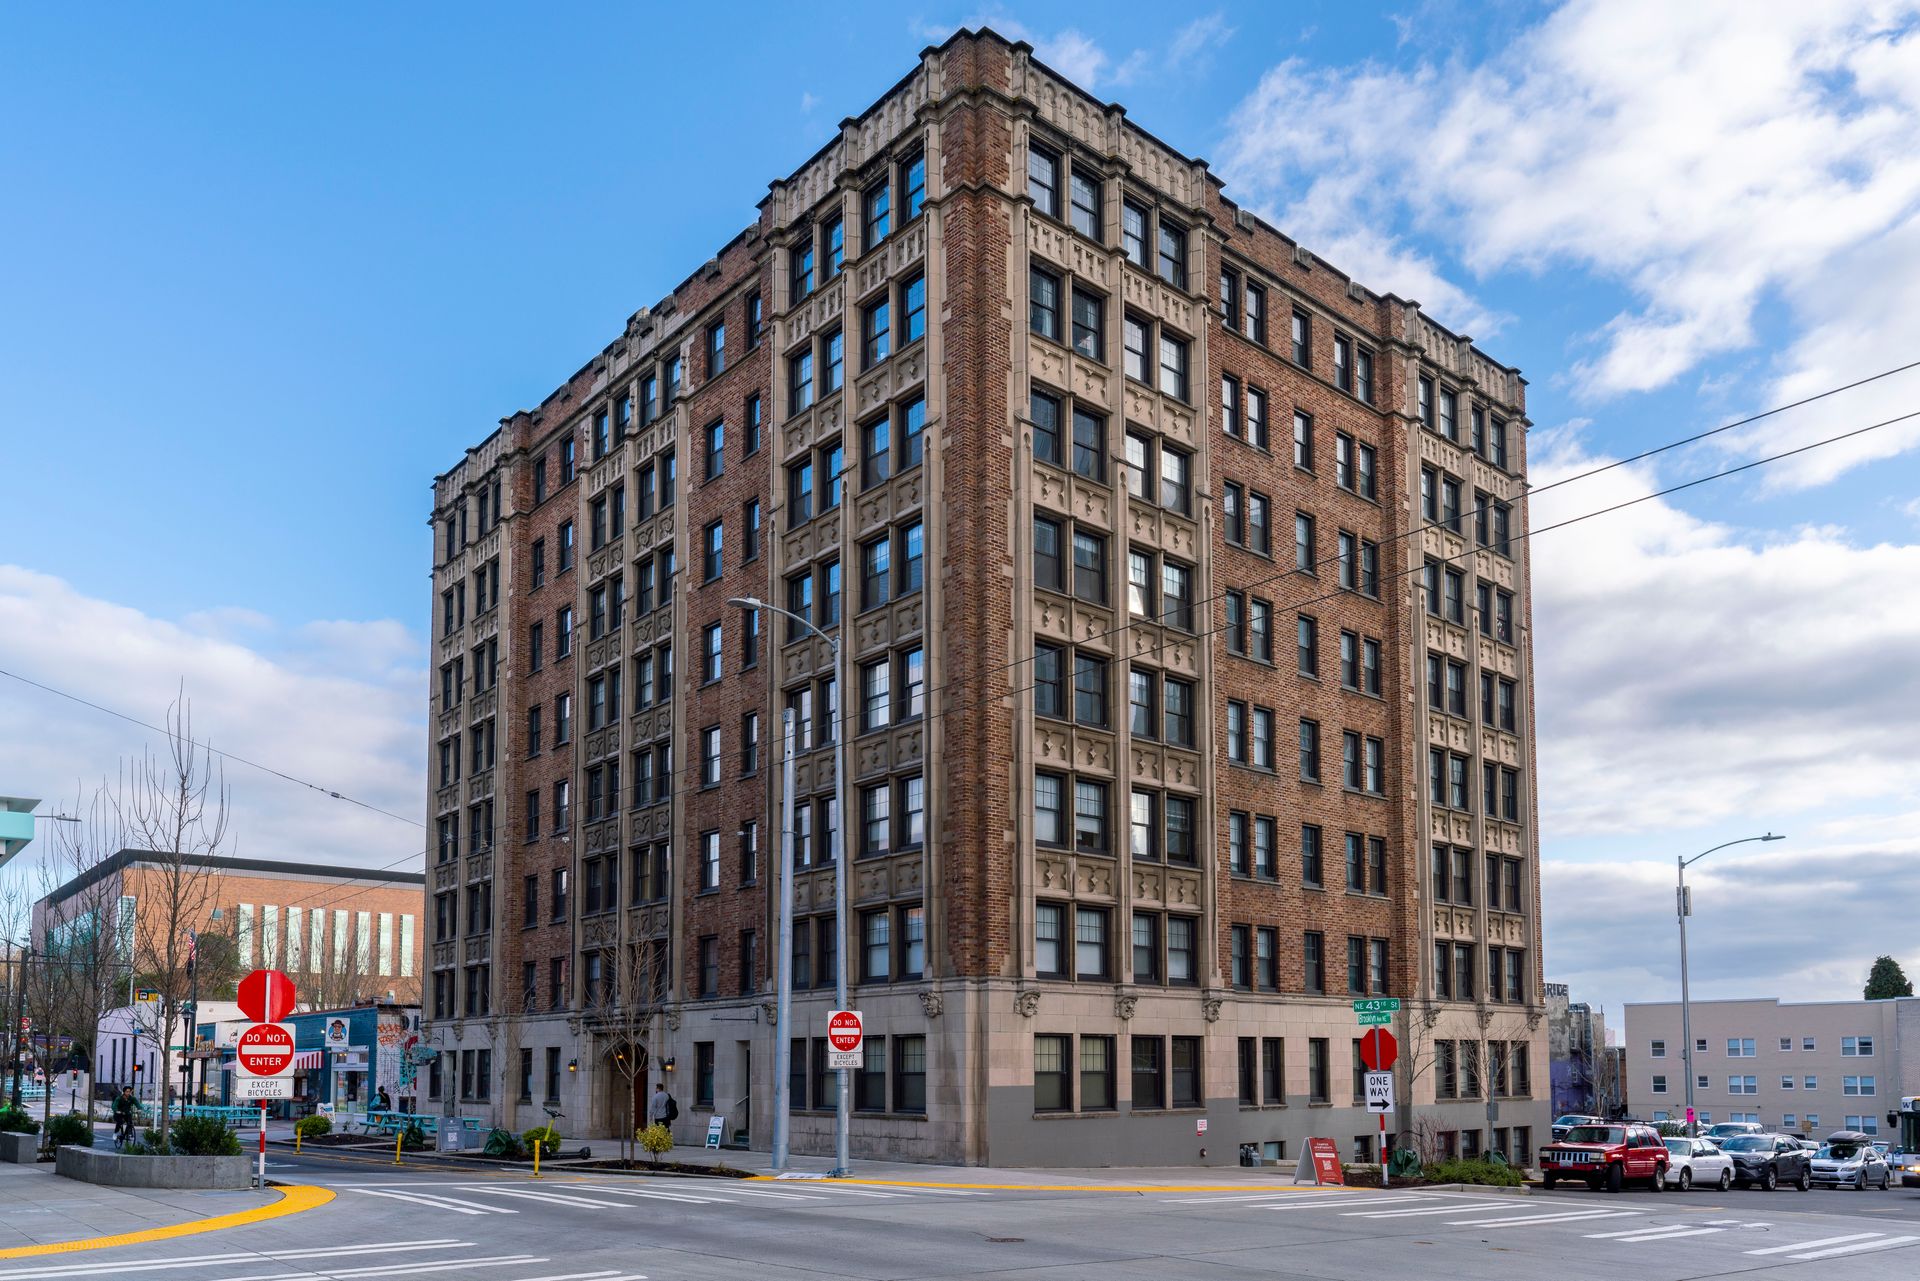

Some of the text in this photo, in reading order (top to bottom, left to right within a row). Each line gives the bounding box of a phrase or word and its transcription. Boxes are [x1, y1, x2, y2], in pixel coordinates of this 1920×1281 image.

[1543, 982, 1568, 998] RIDE
[1359, 1014, 1376, 1024] Brooklyn
[246, 1033, 261, 1043] DO
[266, 1033, 287, 1043] NOT
[835, 1036, 856, 1044] ENTER
[249, 1057, 282, 1066] ENTER
[1369, 1076, 1388, 1086] ONE
[247, 1088, 282, 1097] BICYCLES
[1369, 1087, 1389, 1097] WAY
